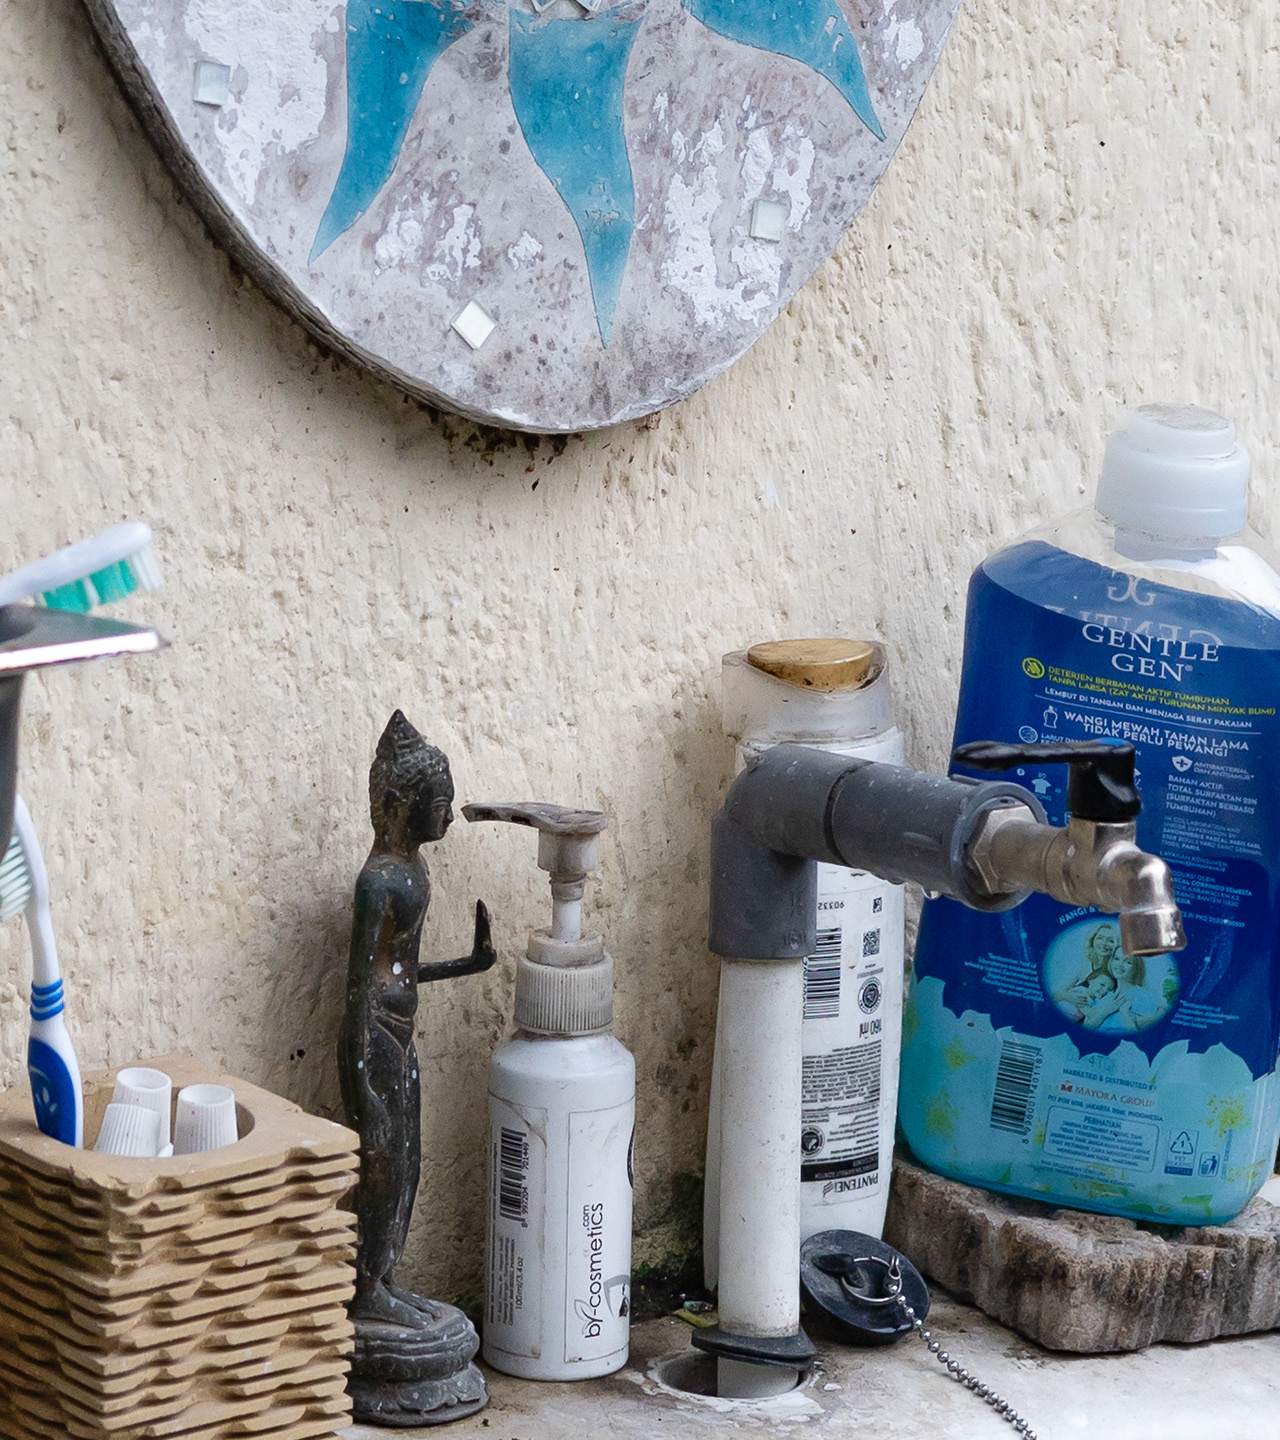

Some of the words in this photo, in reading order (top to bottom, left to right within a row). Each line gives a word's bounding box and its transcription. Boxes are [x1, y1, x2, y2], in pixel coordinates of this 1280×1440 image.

[1082, 623, 1219, 662] GENTLE
[1048, 666, 1093, 682] DETERJEN
[1095, 677, 1144, 693] BERBAHAN
[1146, 687, 1171, 697] AKTIF
[1174, 692, 1230, 705] TUMBUHAN
[1048, 674, 1076, 687] TANPA
[1079, 681, 1107, 694] LABSA
[1109, 687, 1129, 698] (ZAT
[1131, 692, 1156, 702] AKTIF
[1160, 698, 1205, 711] TURUNAN
[1207, 705, 1245, 715] MINYAK
[1248, 708, 1276, 716] BUMI)
[1045, 687, 1077, 700] LEMBUT
[1090, 697, 1123, 708] TANGAN
[1125, 703, 1143, 713] DAN
[1145, 708, 1184, 721] MENJAGA
[1186, 715, 1212, 725] SERAT
[1214, 719, 1252, 728] PAKAIAN
[1064, 711, 1108, 726] WANGI
[1111, 720, 1159, 736] MEWAH
[1164, 730, 1208, 746] TAHAN
[1212, 738, 1249, 751] LAMA
[1083, 723, 1119, 737] TIDAK
[1123, 730, 1163, 746] PERLU
[1167, 740, 1228, 757] PEWANGI
[1168, 775, 1198, 786] BAHAN
[1168, 784, 1193, 794] TOTAL
[1195, 789, 1242, 802] SURFAKTAN
[1063, 1068, 1098, 1081] MARKETED
[1105, 1077, 1148, 1090] DISTRIBUTED
[1074, 1085, 1118, 1102] MAYORA
[1120, 1095, 1155, 1108] GROUP
[839, 1173, 879, 1193] PANTENE
[584, 1202, 603, 1339] by-cosmetics
